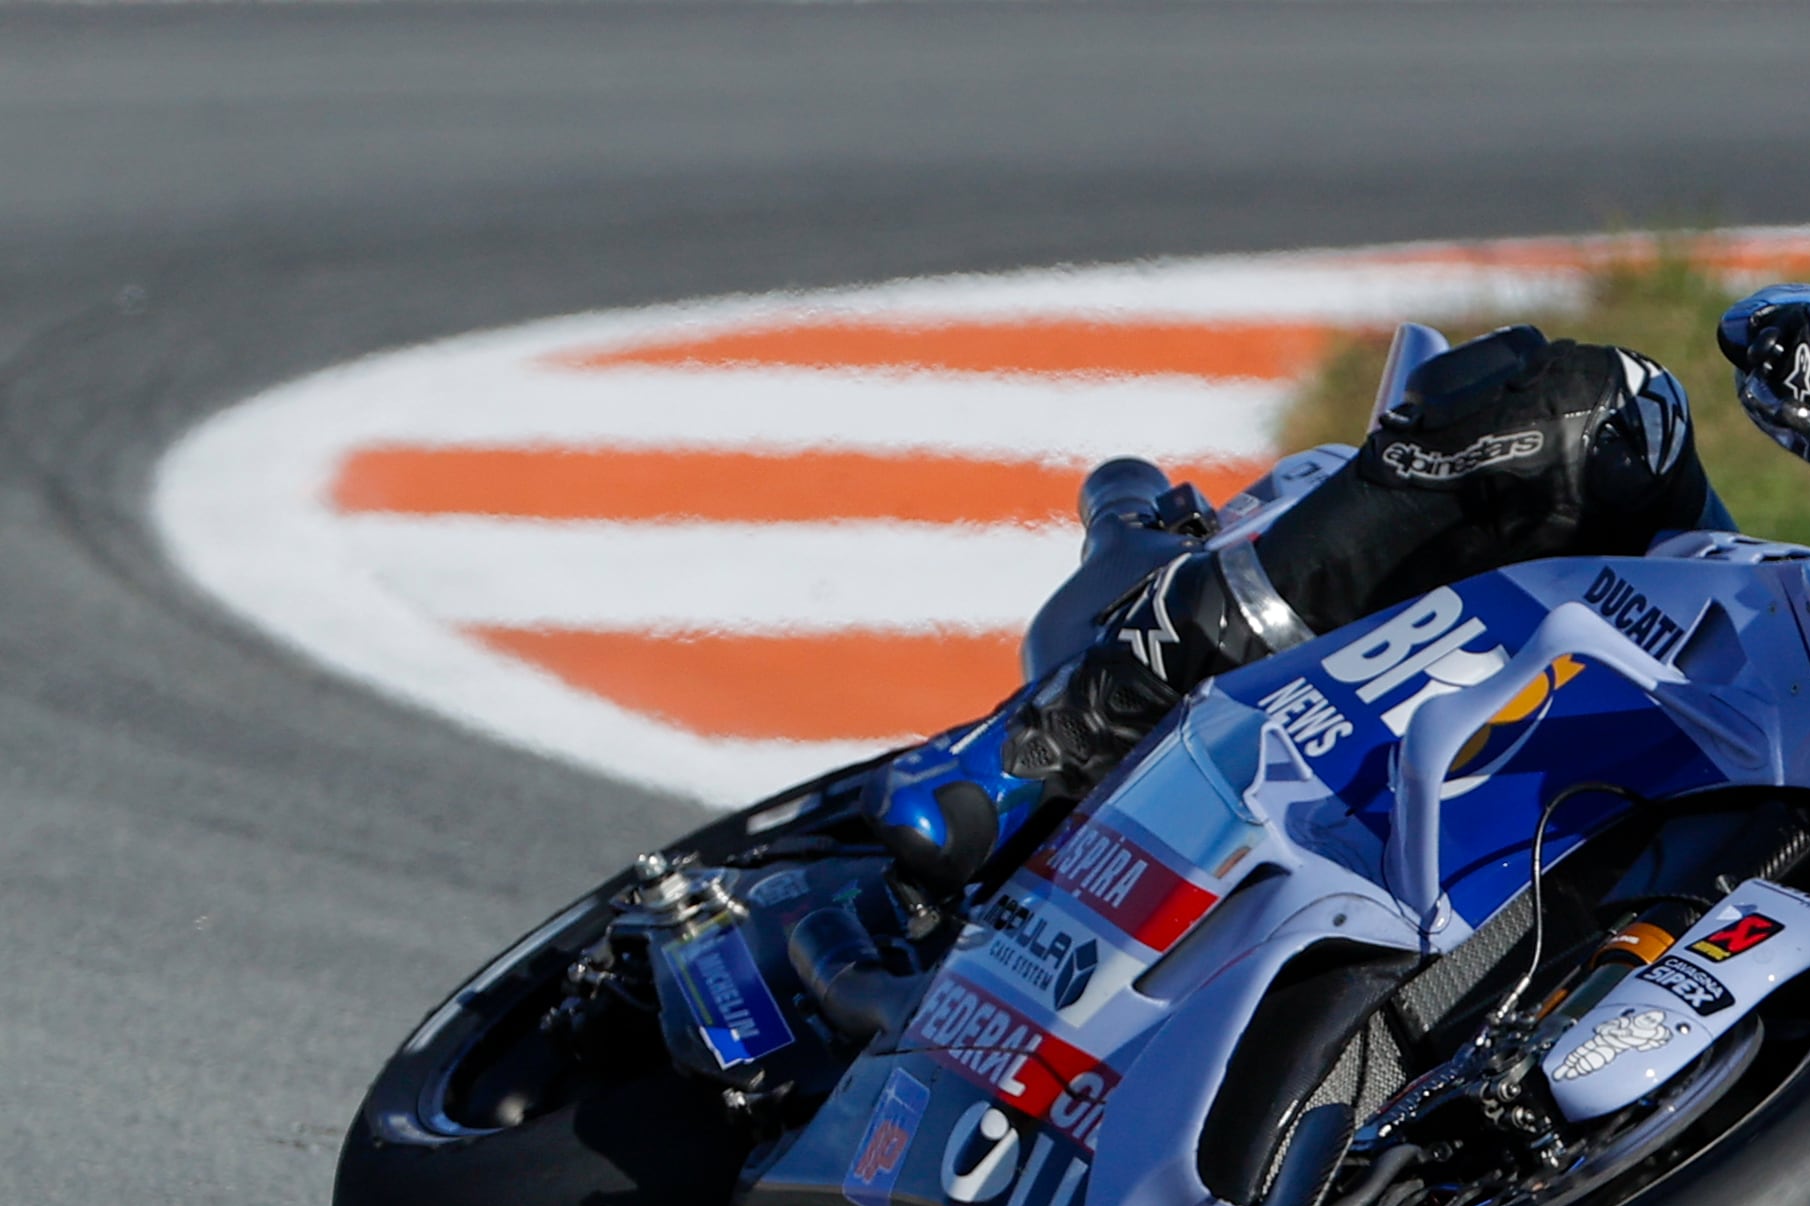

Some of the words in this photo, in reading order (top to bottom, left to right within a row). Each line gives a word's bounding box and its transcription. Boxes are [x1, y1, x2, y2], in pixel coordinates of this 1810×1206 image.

[1382, 431, 1545, 479] alpinestars
[1583, 566, 1684, 664] DUCATI
[1257, 676, 1354, 758] NEWS
[1011, 950, 1054, 992] SYSTEM
[1642, 966, 1716, 1009] SIPEX
[918, 979, 1044, 1098] FEDERAL
